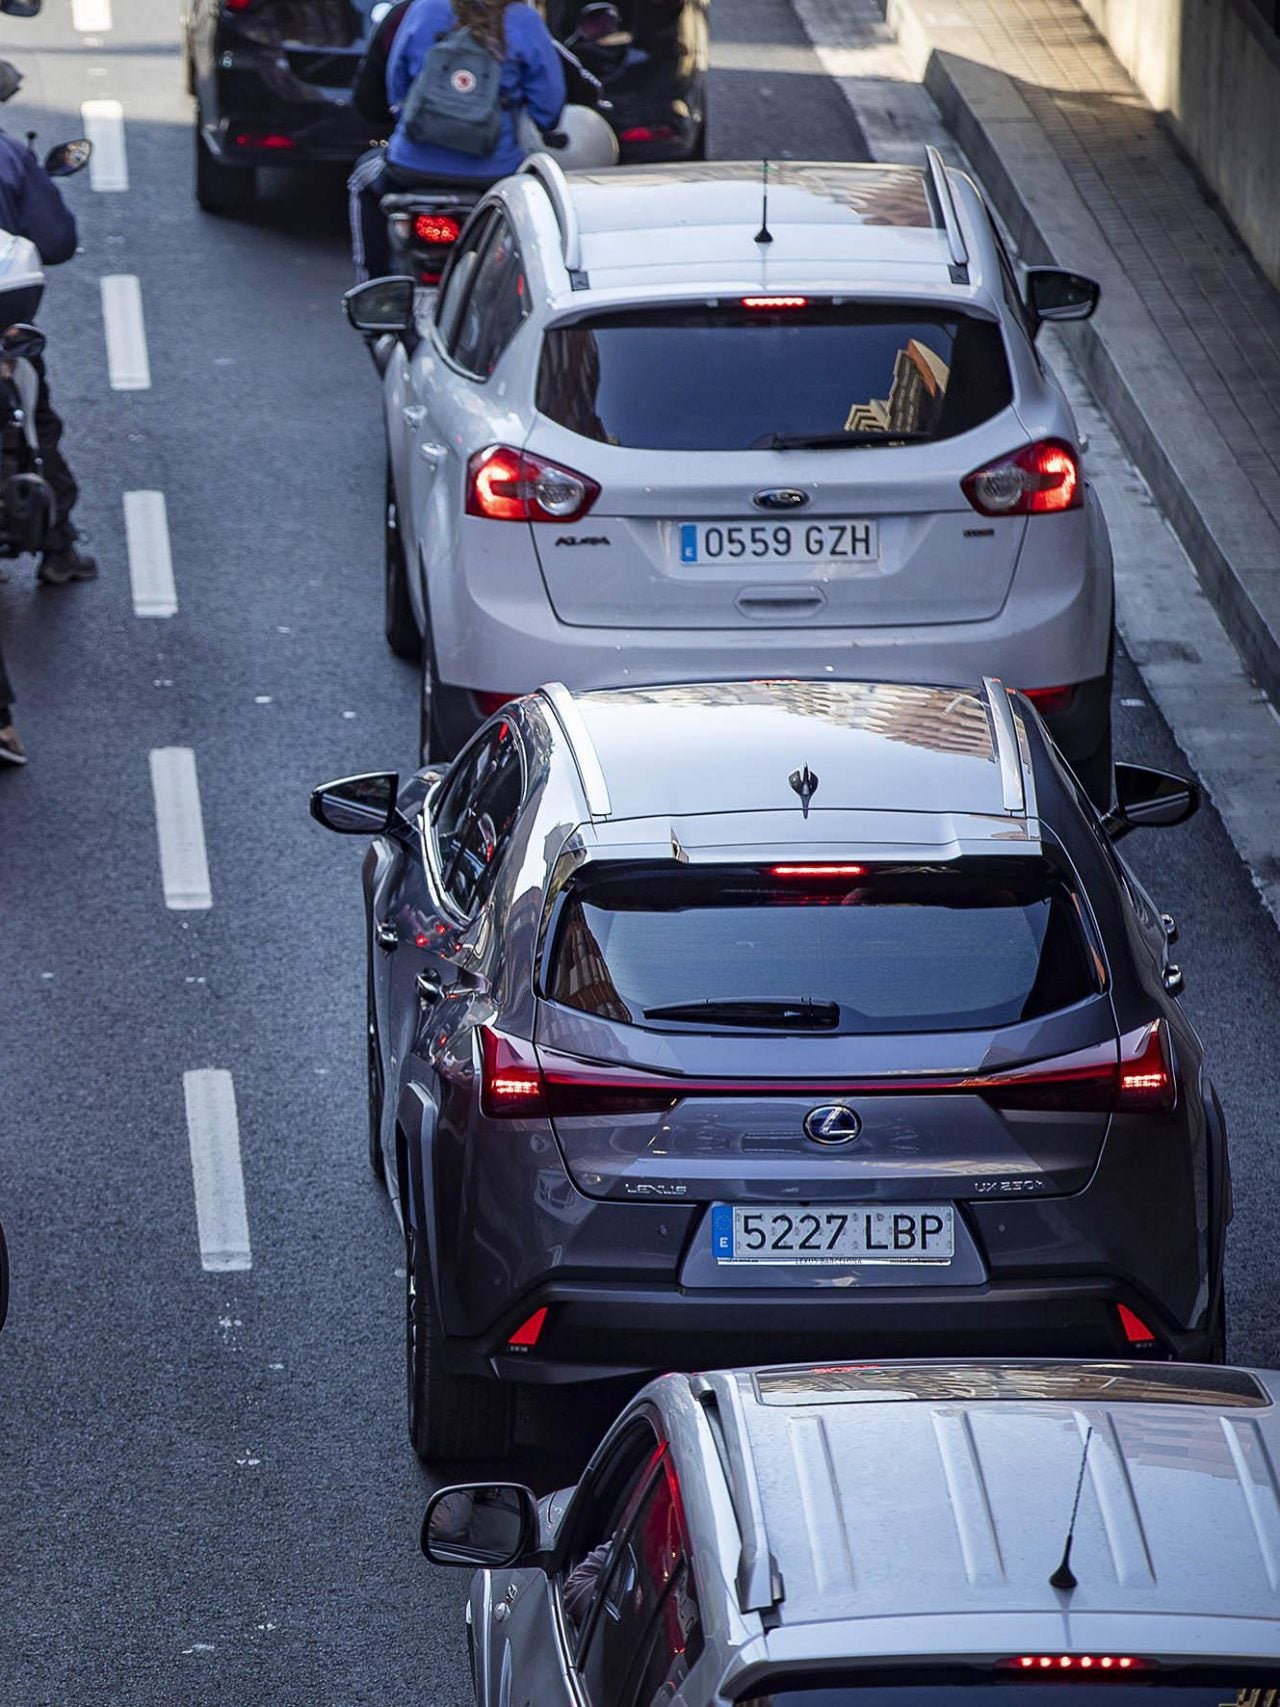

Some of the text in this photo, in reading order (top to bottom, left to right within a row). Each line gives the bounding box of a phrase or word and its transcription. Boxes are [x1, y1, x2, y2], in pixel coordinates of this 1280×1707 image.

[705, 526, 792, 558] 0559
[805, 524, 871, 556] GZH
[625, 1183, 687, 1195] LEXUS
[719, 1213, 944, 1251] E 5227 LBP
